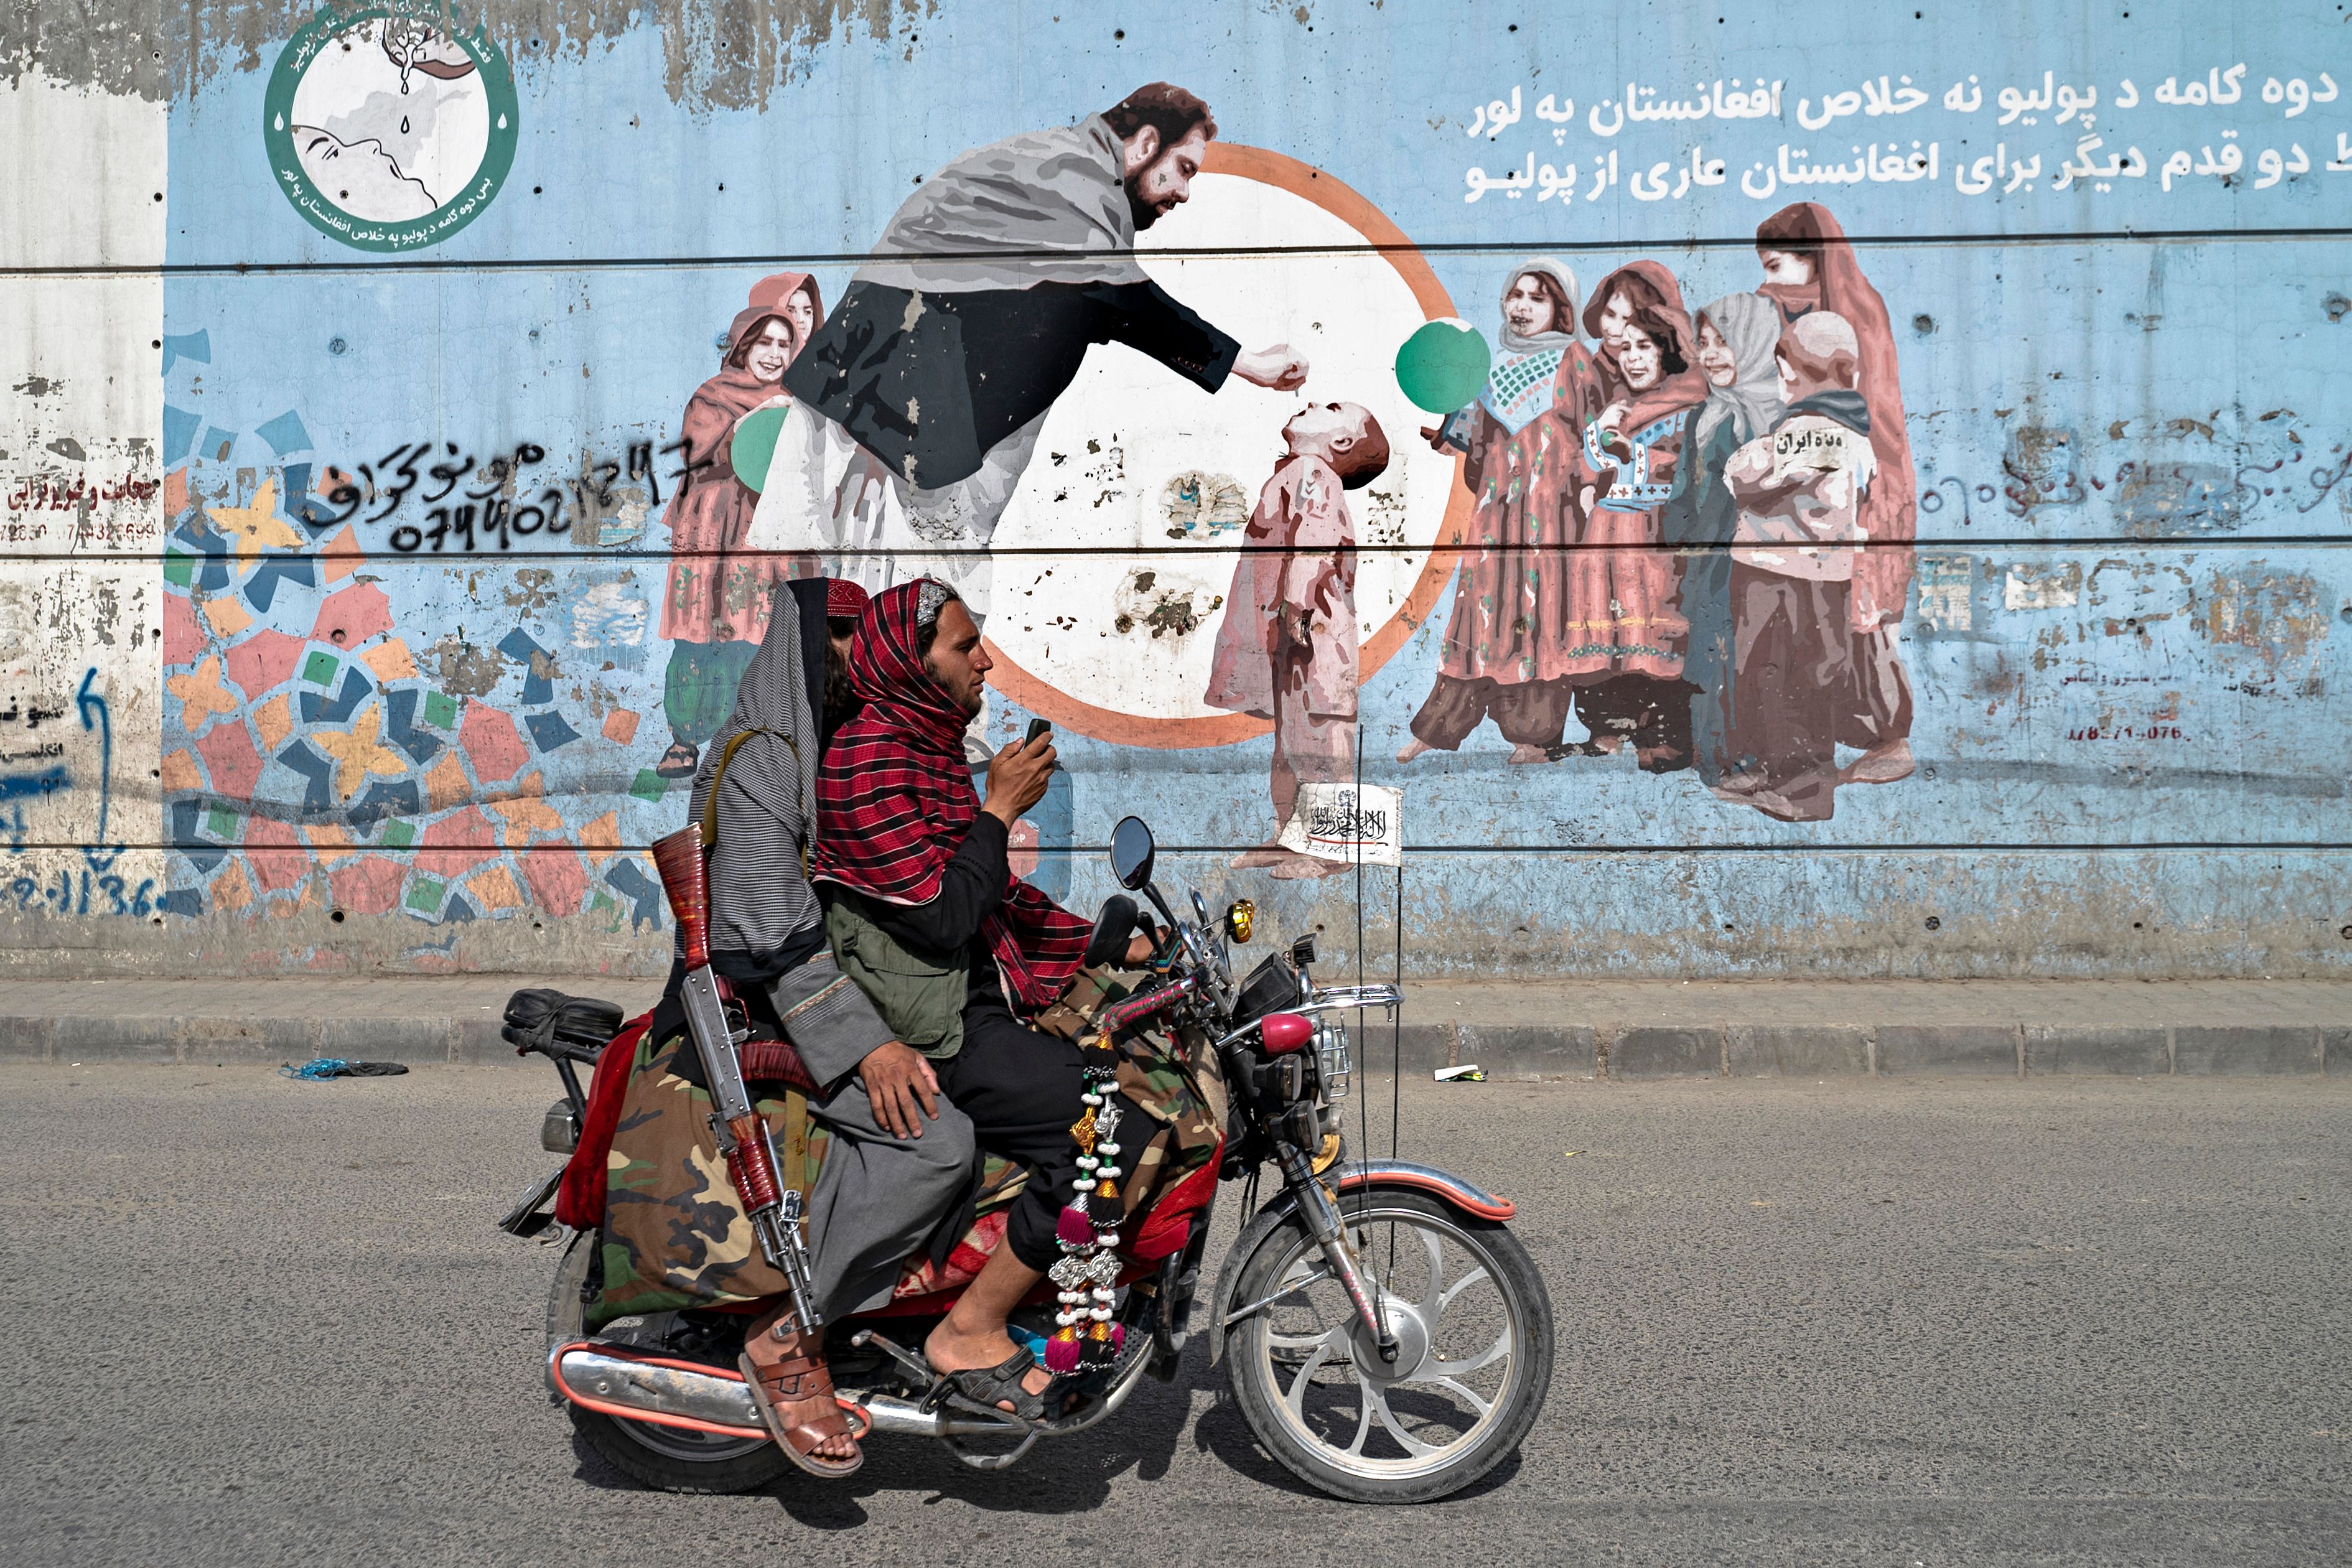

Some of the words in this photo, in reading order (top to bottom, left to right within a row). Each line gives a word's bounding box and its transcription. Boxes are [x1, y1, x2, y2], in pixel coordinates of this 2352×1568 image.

[470, 37, 494, 63] فقط
[1467, 85, 1522, 138] لور
[1589, 77, 1782, 137] افغانستان
[1796, 75, 1929, 131] خلاص
[1943, 75, 1982, 113] نه
[1997, 70, 2097, 129] پولیو
[2115, 78, 2139, 108] د
[2262, 72, 2338, 118] دوه
[1535, 93, 1575, 146] په
[281, 169, 299, 182] لور
[1464, 151, 1577, 205] پولیو
[1585, 149, 1618, 202] از
[1630, 146, 1726, 202] عاری
[1740, 140, 1939, 200] افغانستان
[1955, 142, 2041, 195] برای
[2051, 133, 2147, 193] دیگر
[2161, 130, 2242, 192] قدم
[2254, 143, 2310, 190] دو
[292, 184, 303, 197] په
[459, 198, 476, 214] دوه
[476, 177, 493, 200] بس
[300, 197, 351, 233] افغانستان
[352, 228, 385, 240] خلاص
[402, 228, 427, 245] پولیو
[429, 225, 436, 233] د
[388, 233, 399, 248] په
